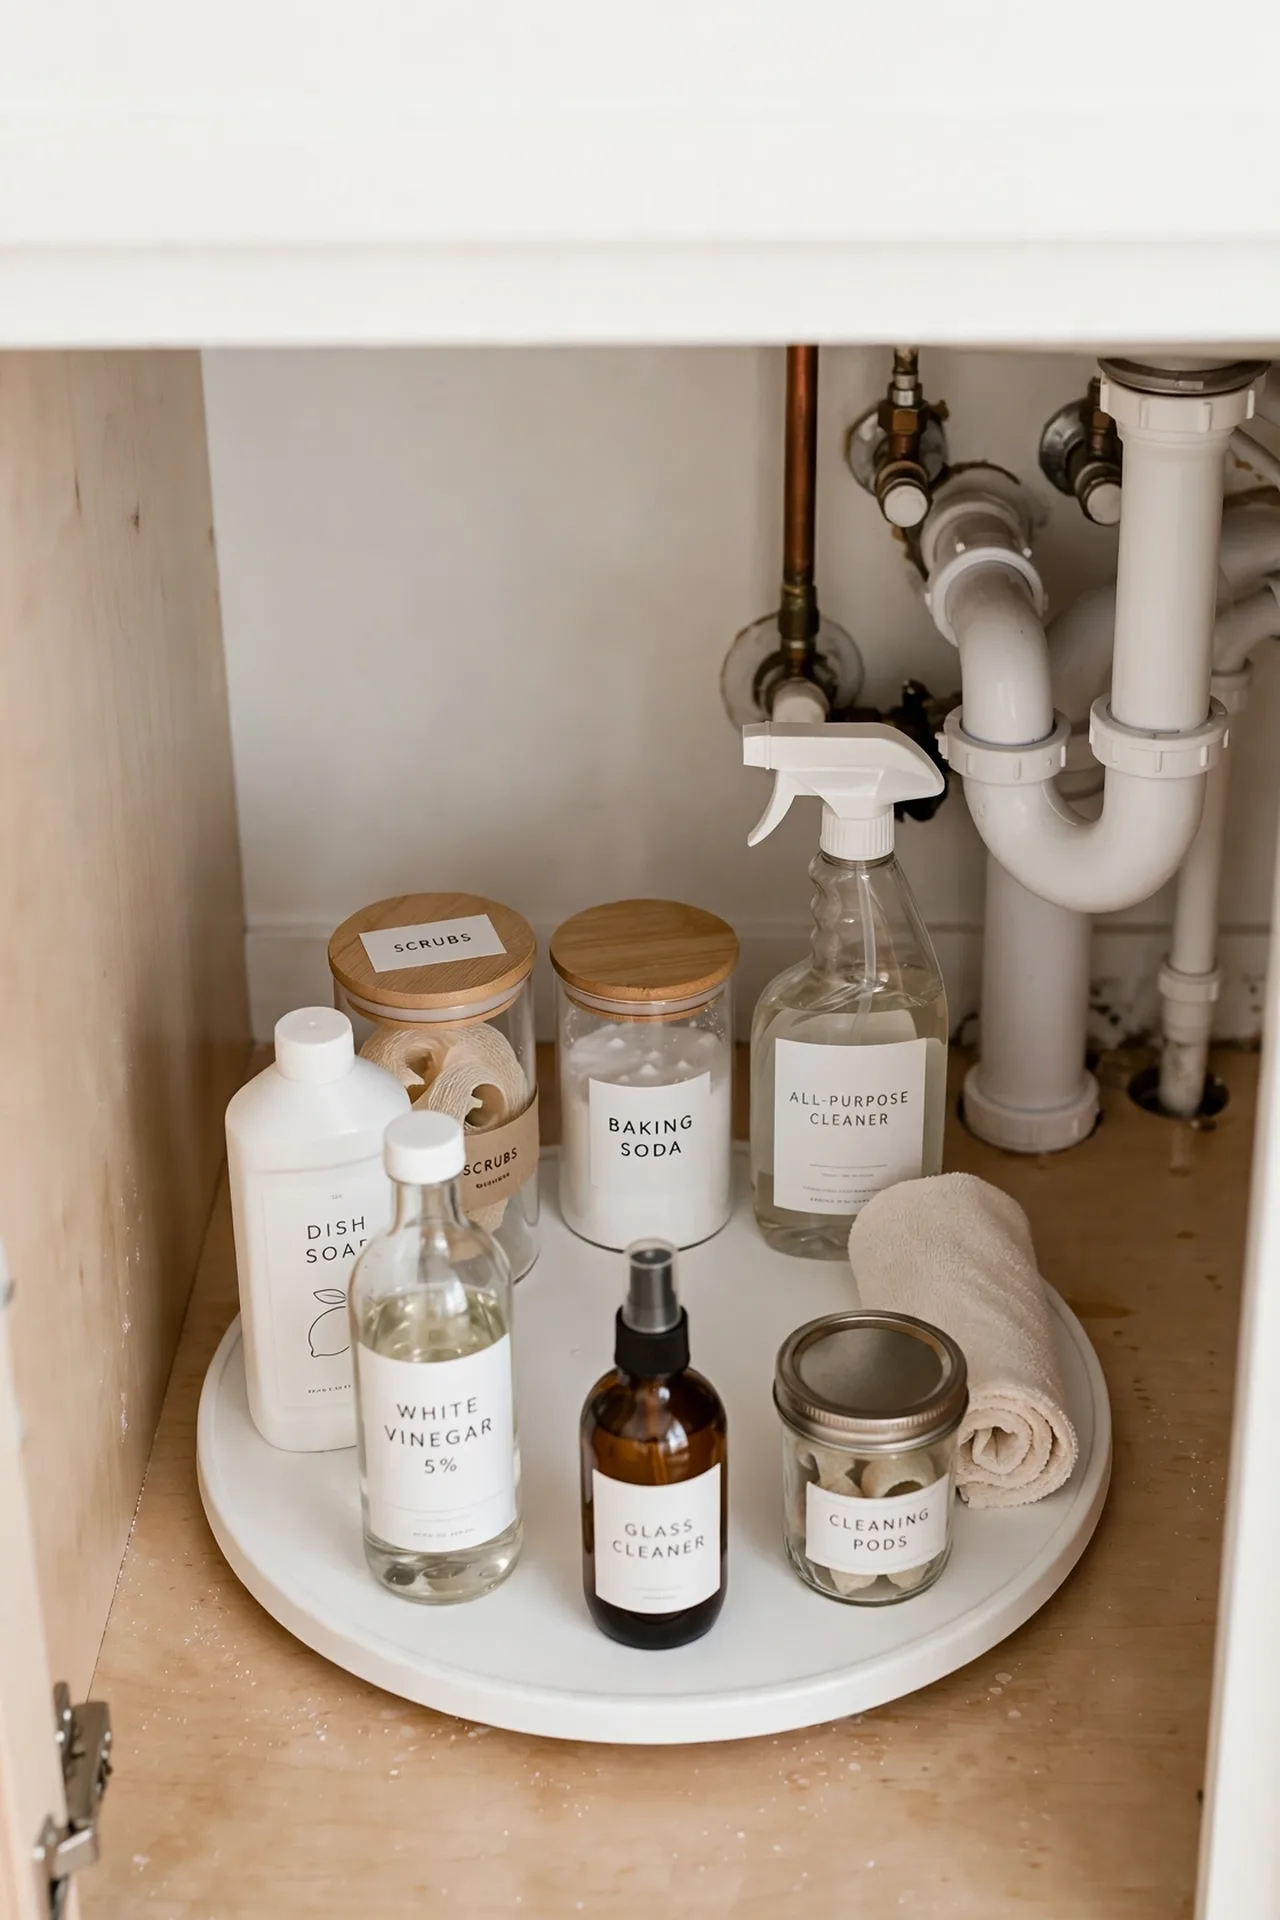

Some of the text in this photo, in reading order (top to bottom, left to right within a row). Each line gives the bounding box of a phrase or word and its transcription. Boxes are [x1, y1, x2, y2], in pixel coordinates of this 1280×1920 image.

[393, 933, 472, 953] SCRUBS
[789, 1090, 909, 1108] ALL-PURPOSE
[608, 1114, 692, 1136] BAKING
[809, 1112, 888, 1127] CLEANER
[620, 1140, 682, 1158] SODA
[463, 1147, 518, 1176] SCRUBS
[306, 1215, 365, 1240] DISH
[396, 1396, 478, 1421] WHITE
[383, 1417, 492, 1448] VINEGAR
[423, 1457, 458, 1474] 5%
[624, 1519, 693, 1538] GLASS
[829, 1507, 929, 1532] CLEANING
[611, 1535, 704, 1559] CLEANER
[853, 1535, 908, 1552] PODS
